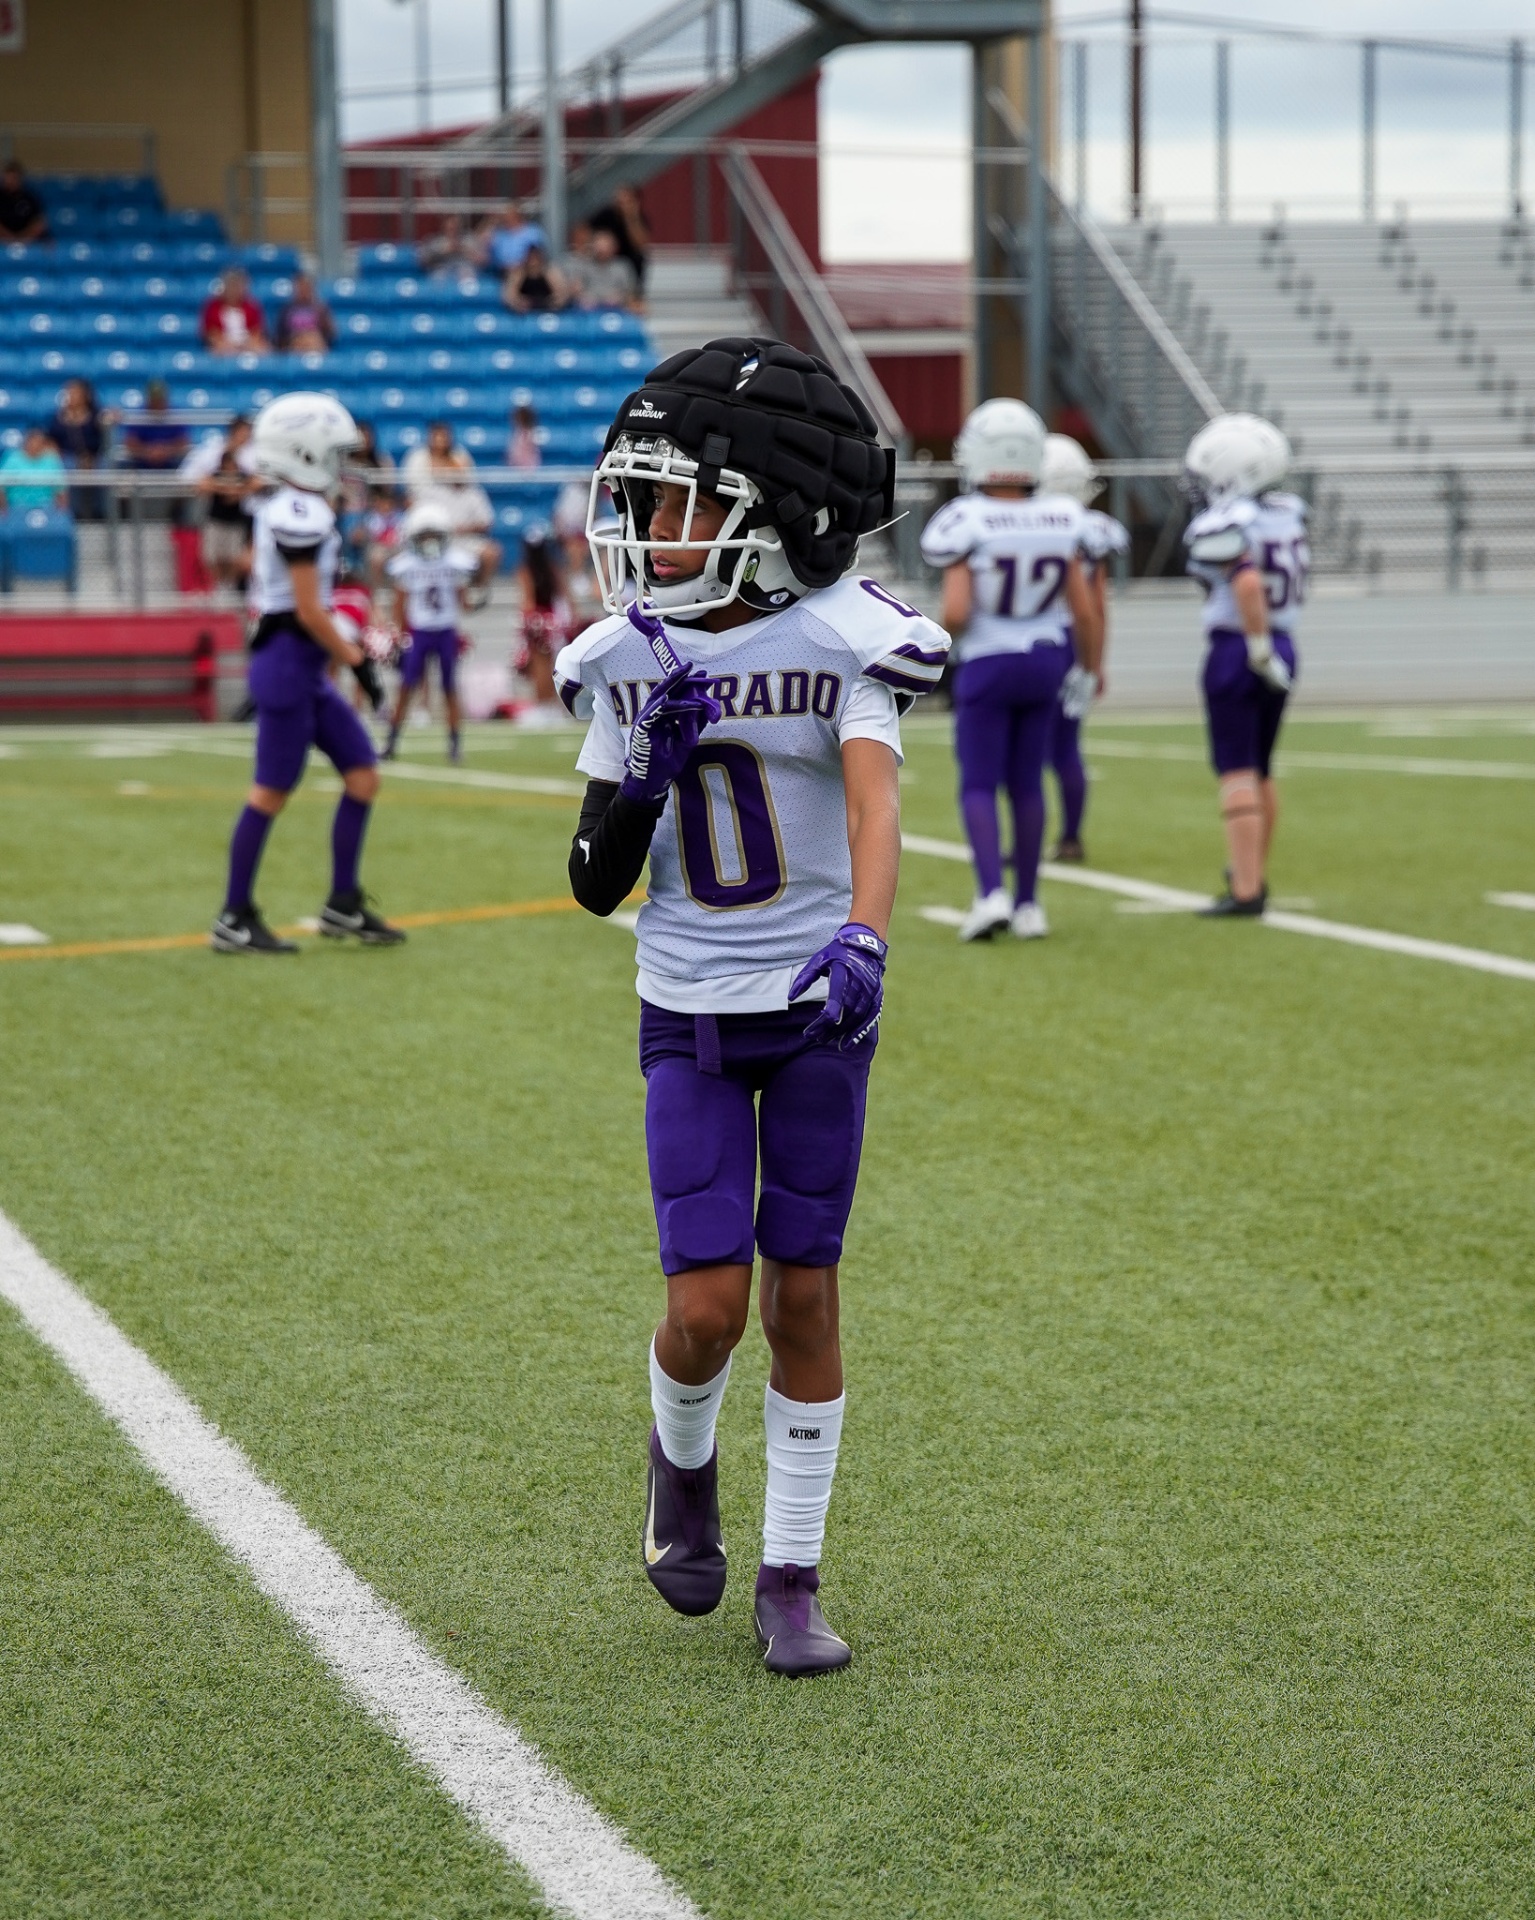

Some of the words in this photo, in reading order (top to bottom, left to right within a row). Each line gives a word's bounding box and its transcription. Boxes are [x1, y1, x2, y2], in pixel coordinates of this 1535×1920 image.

[995, 556, 1067, 618] 12
[651, 634, 680, 677] XTRND
[609, 668, 844, 729] ALRADO
[672, 737, 790, 914] 0
[679, 1392, 712, 1406] NXTRND
[788, 1426, 821, 1441] NXTRND
